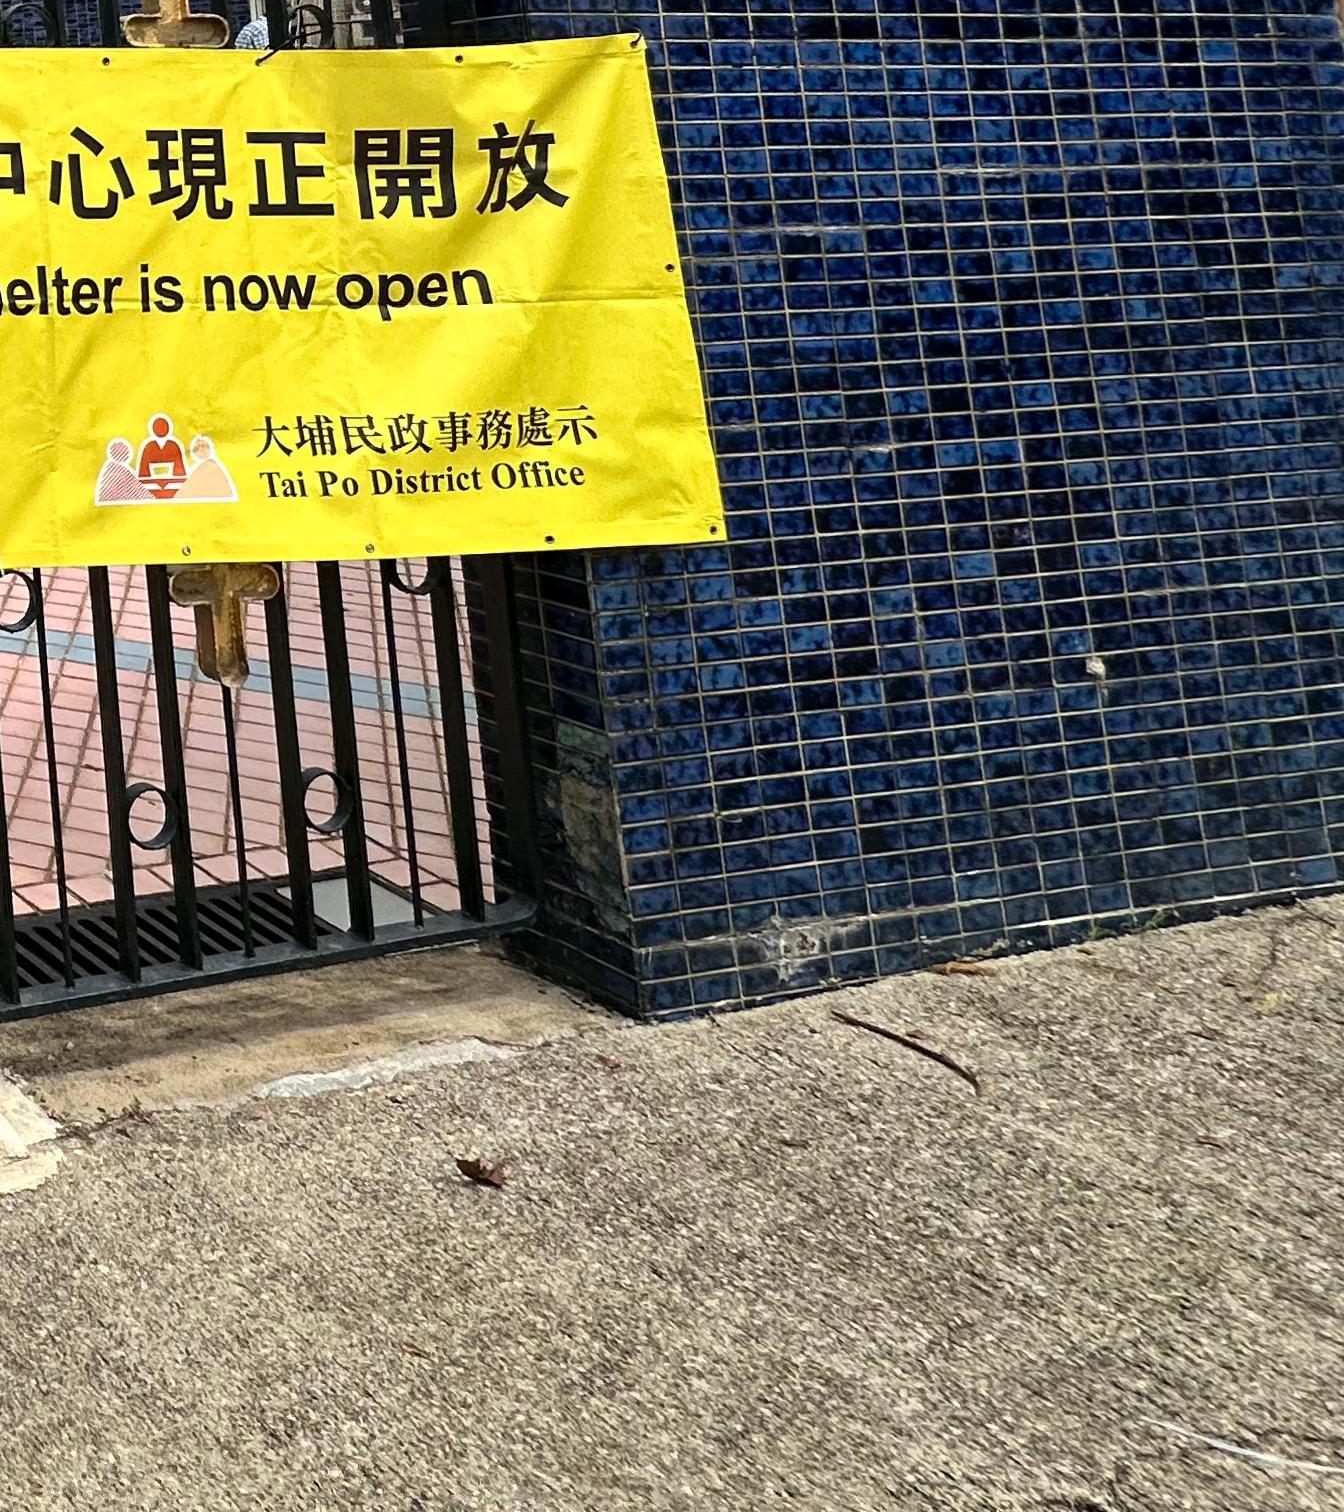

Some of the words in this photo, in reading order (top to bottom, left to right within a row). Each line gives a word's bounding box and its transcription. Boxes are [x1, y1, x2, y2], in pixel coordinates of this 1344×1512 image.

[140, 263, 184, 313] is
[203, 274, 317, 312] now
[336, 269, 494, 322] open
[253, 403, 599, 458] 大埔民政事務處示
[258, 471, 308, 499] Tai
[317, 471, 360, 498] Po
[369, 466, 483, 496] District
[491, 460, 586, 490] Office
